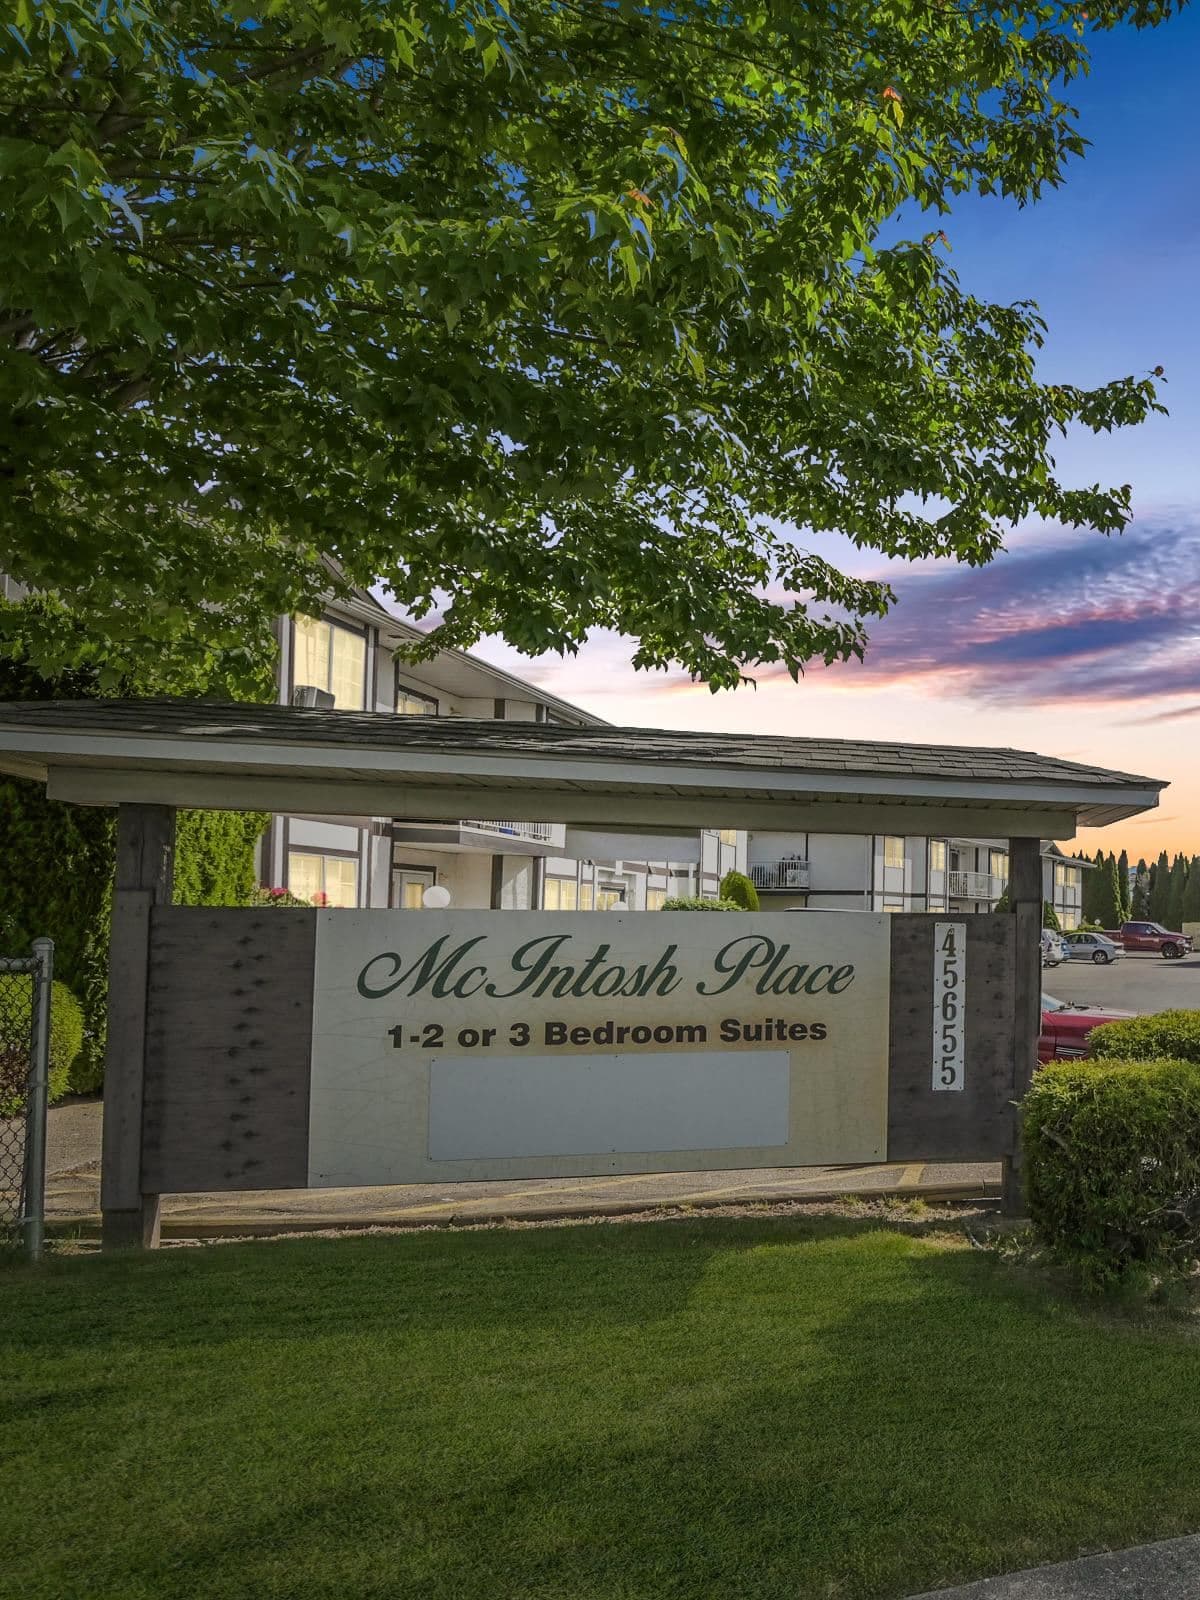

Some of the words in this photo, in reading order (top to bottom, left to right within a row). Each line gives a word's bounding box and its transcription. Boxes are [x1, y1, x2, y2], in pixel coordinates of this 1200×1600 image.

[695, 934, 856, 998] Place
[387, 1023, 444, 1049] 1-2
[457, 1028, 497, 1048] or
[508, 1022, 531, 1047] 3
[544, 1020, 707, 1046] Bedroom
[719, 1017, 828, 1043] Suites
[940, 927, 958, 1086] 45655
